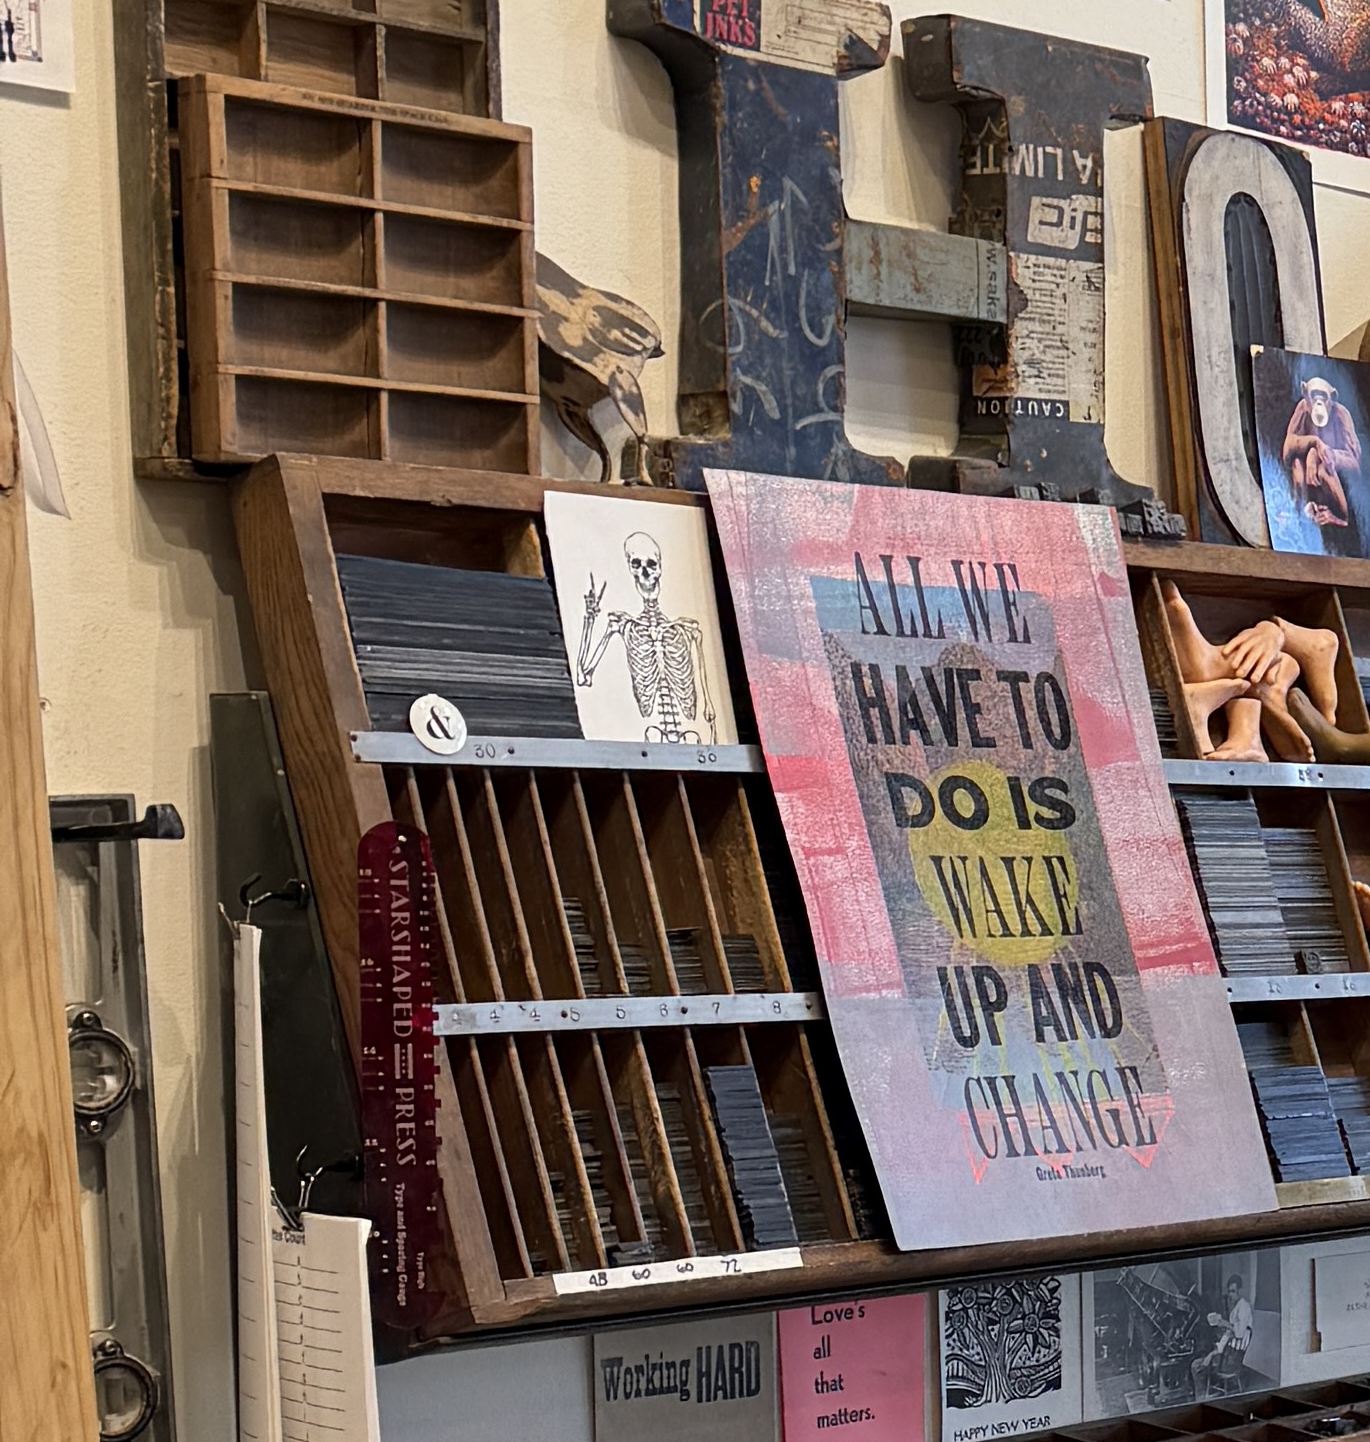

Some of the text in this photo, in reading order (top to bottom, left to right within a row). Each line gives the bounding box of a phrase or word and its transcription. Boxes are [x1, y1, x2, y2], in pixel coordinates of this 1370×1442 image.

[855, 552, 1031, 644] ALL WE
[855, 665, 1071, 752] HAVE TO
[886, 774, 1078, 831] DO IS
[930, 855, 1083, 939] WAKE
[389, 860, 416, 1166] STARSHAPED PRESS
[939, 962, 1123, 1049] UP AND
[964, 1066, 1157, 1160] CHANGE
[811, 1304, 865, 1325] Love's
[603, 1341, 760, 1403] Working HARD
[817, 1409, 875, 1429] matters.
[954, 1415, 1051, 1442] HAPPY NEW YEAR
